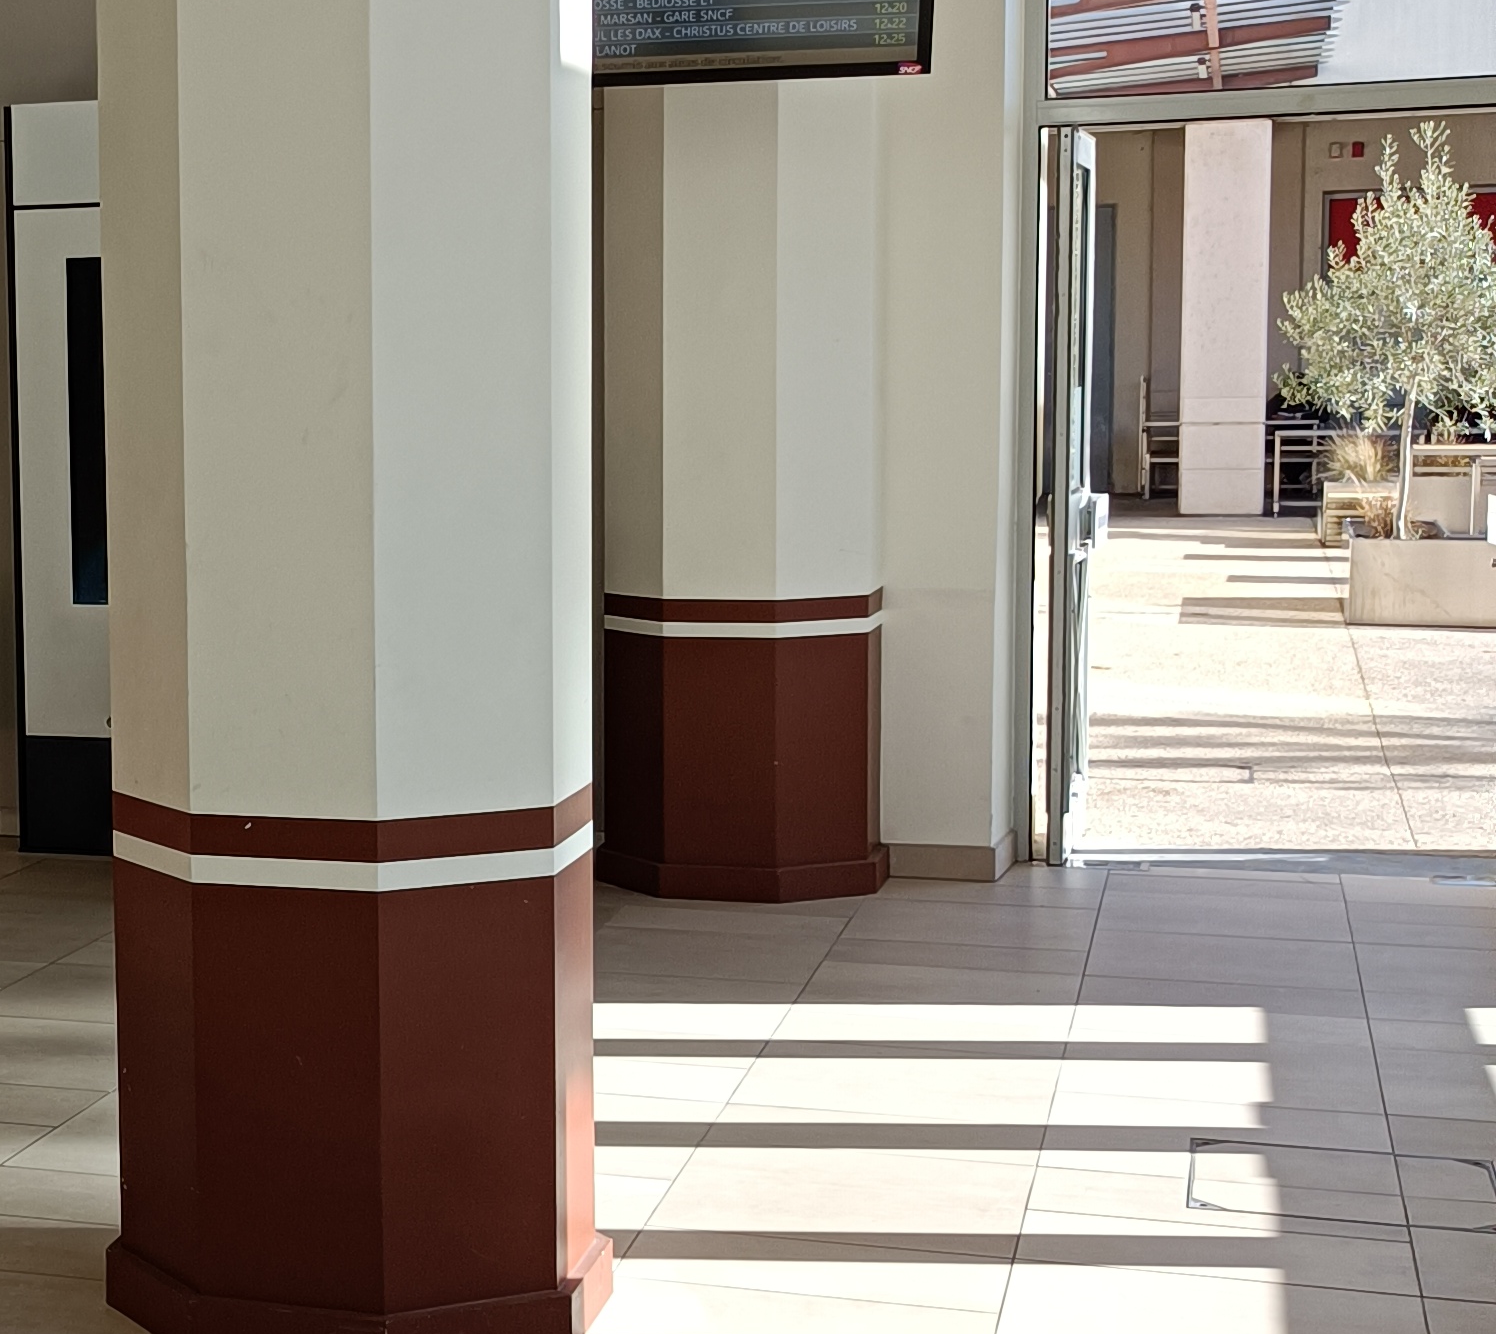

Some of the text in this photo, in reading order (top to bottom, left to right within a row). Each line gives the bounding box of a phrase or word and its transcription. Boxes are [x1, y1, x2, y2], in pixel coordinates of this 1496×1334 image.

[600, 13, 653, 25] MARSAN
[664, 10, 697, 23] GARE
[700, 9, 734, 21] SNCF
[610, 29, 633, 41] LES
[636, 28, 662, 40] DAX
[673, 25, 734, 38] CHRISTUS
[737, 22, 785, 35] CENTRE
[789, 21, 806, 33] DE
[810, 19, 857, 32] LOISIRS
[596, 44, 637, 56] LANOT
